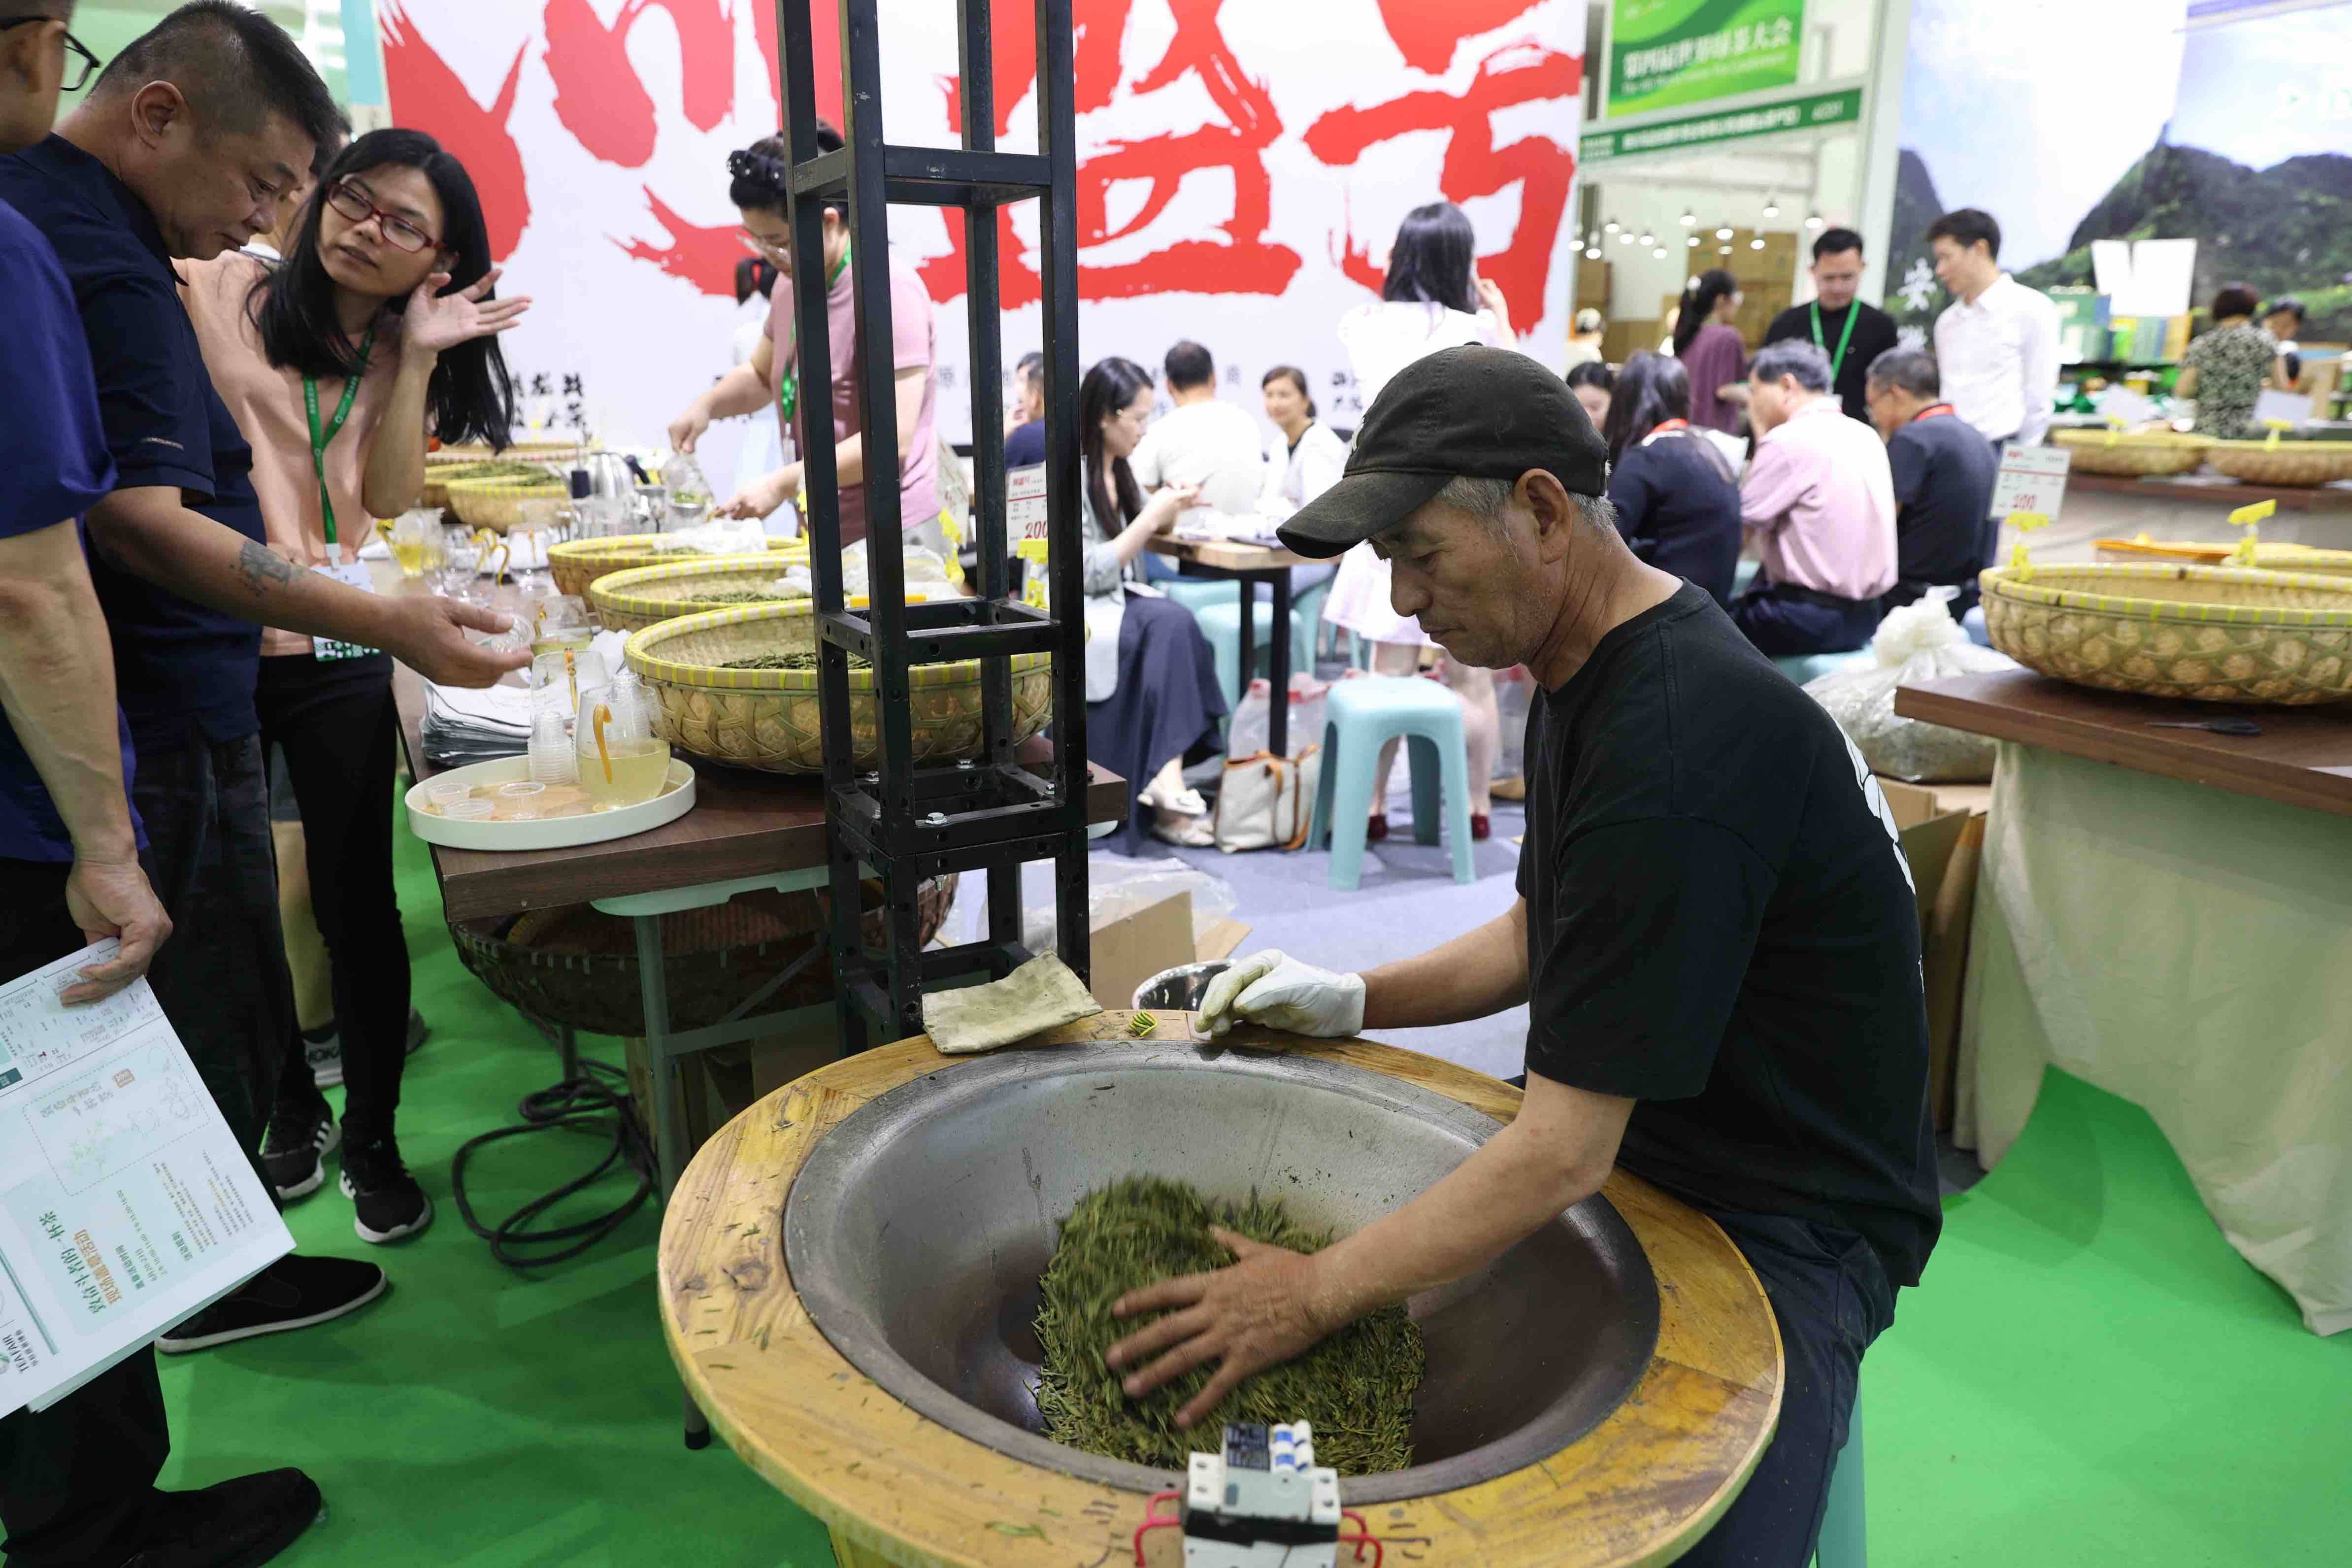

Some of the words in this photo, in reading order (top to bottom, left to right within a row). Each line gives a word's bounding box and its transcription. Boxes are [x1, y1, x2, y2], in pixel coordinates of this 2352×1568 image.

[39, 1210, 106, 1313] 致奋斗者的一杯茶
